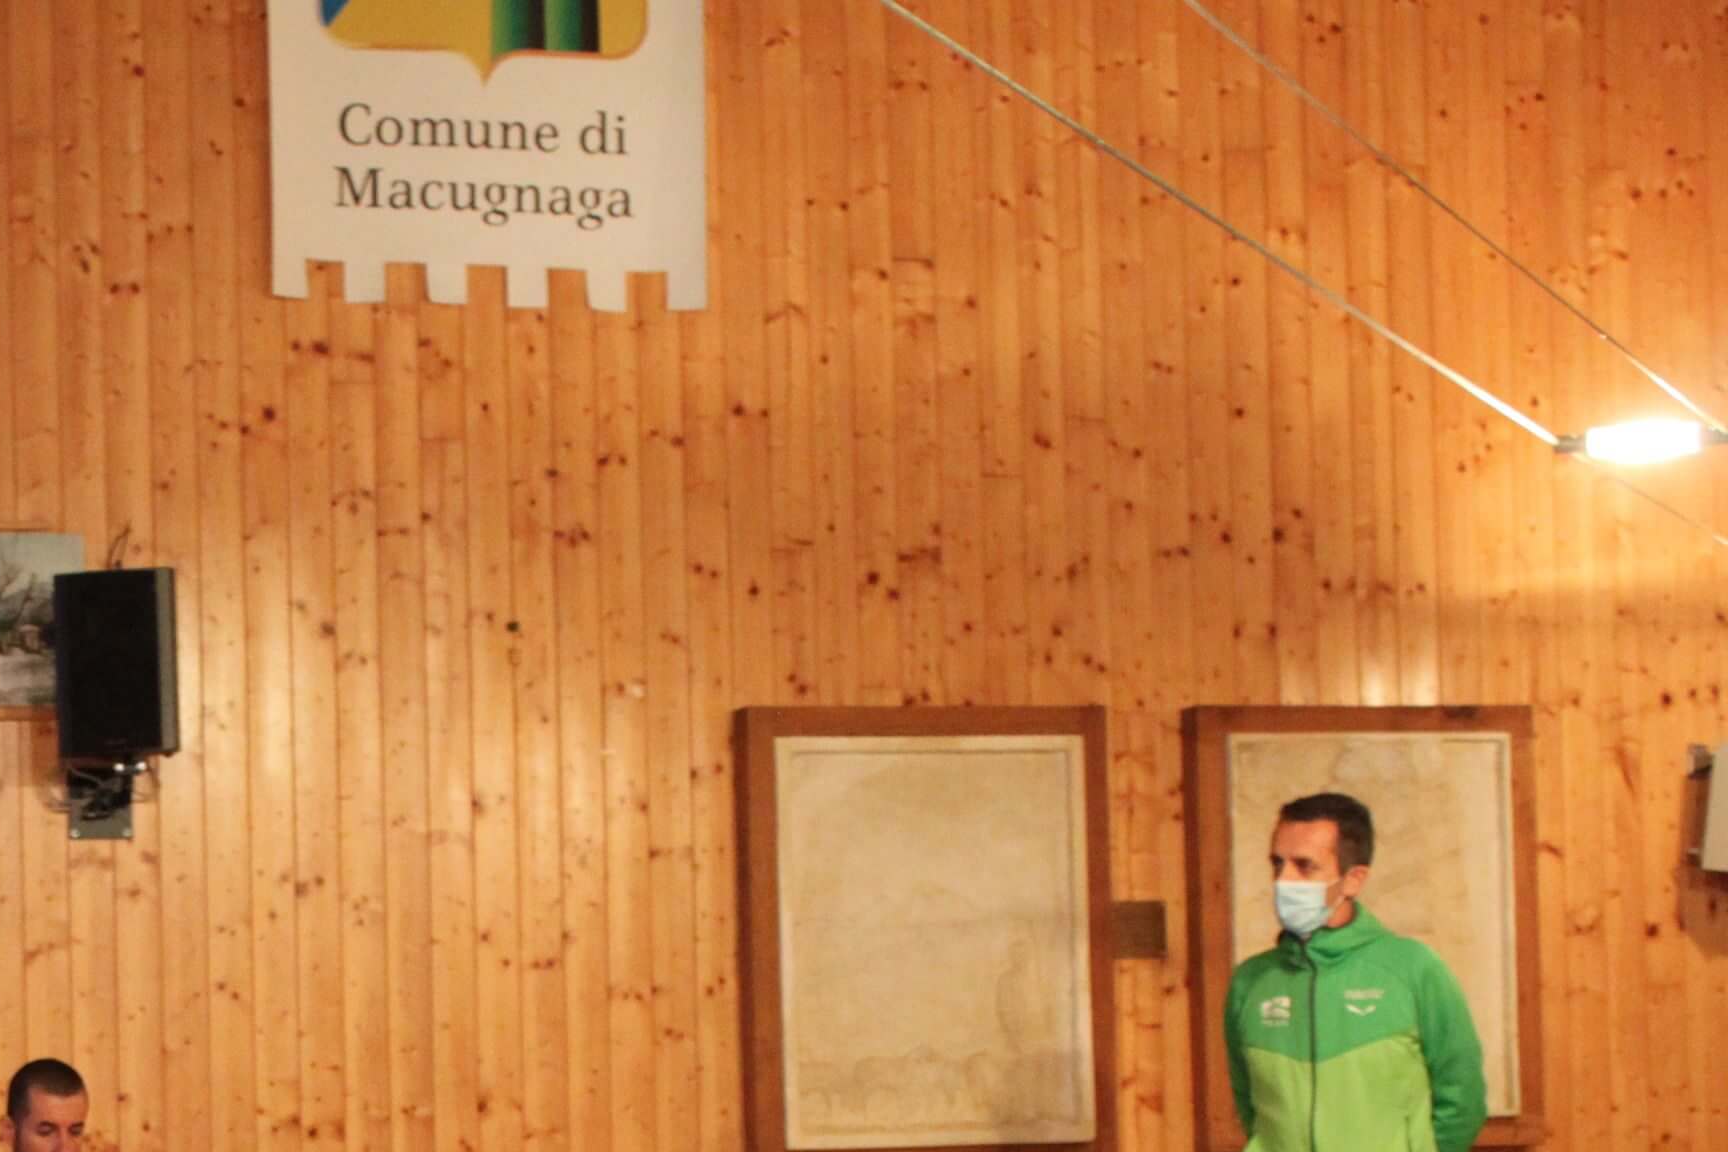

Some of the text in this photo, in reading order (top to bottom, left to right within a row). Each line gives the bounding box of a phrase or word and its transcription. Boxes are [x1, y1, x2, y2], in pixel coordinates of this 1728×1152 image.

[337, 102, 629, 155] Comune di
[333, 165, 634, 230] Macugnaga
